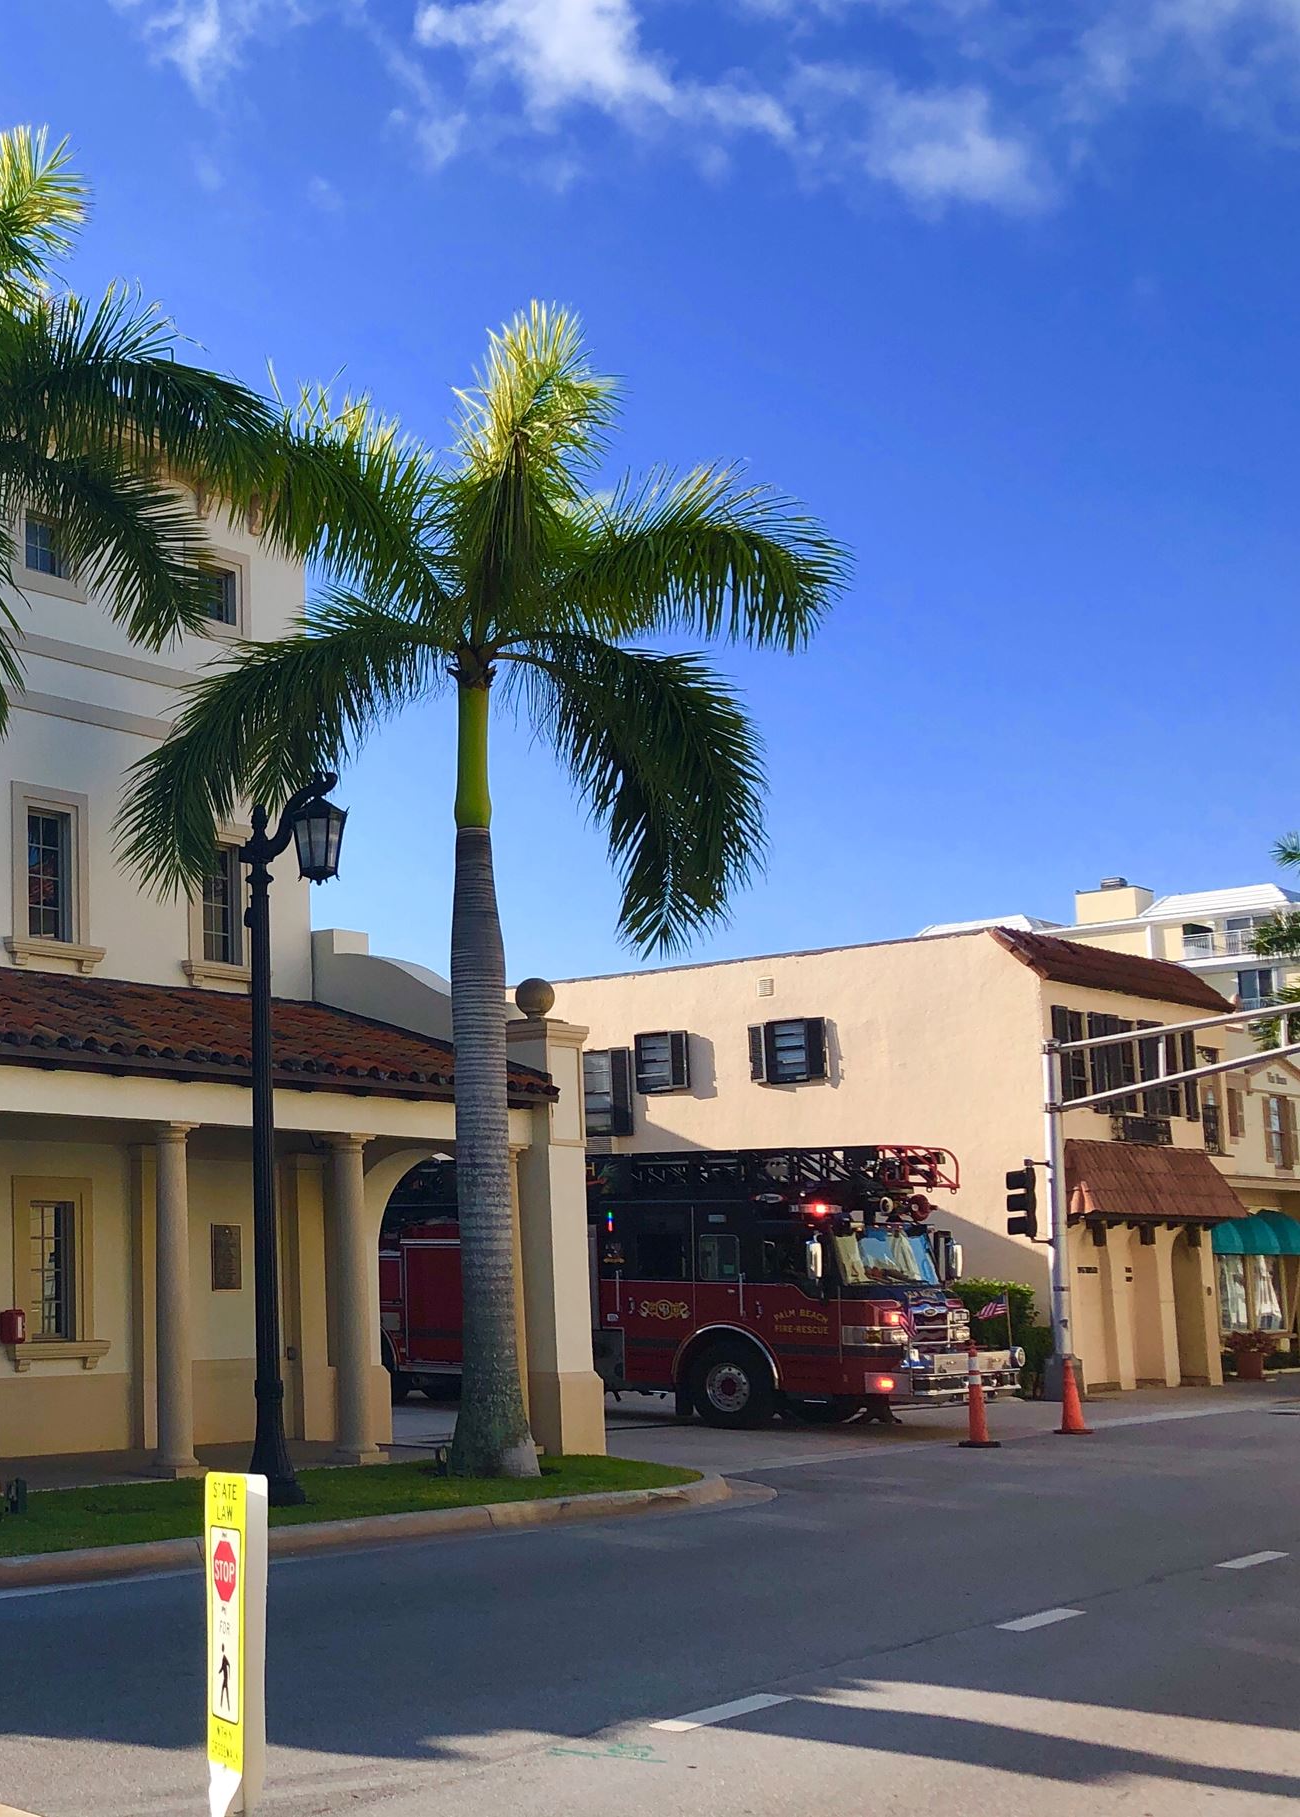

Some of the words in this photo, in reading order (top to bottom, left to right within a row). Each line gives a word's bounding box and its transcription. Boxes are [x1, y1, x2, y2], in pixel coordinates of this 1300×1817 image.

[773, 1309, 796, 1321] PALM
[799, 1308, 829, 1324] BEACH
[216, 1504, 233, 1522] LAW
[214, 1559, 236, 1583] STOP
[218, 1619, 232, 1637] FOR
